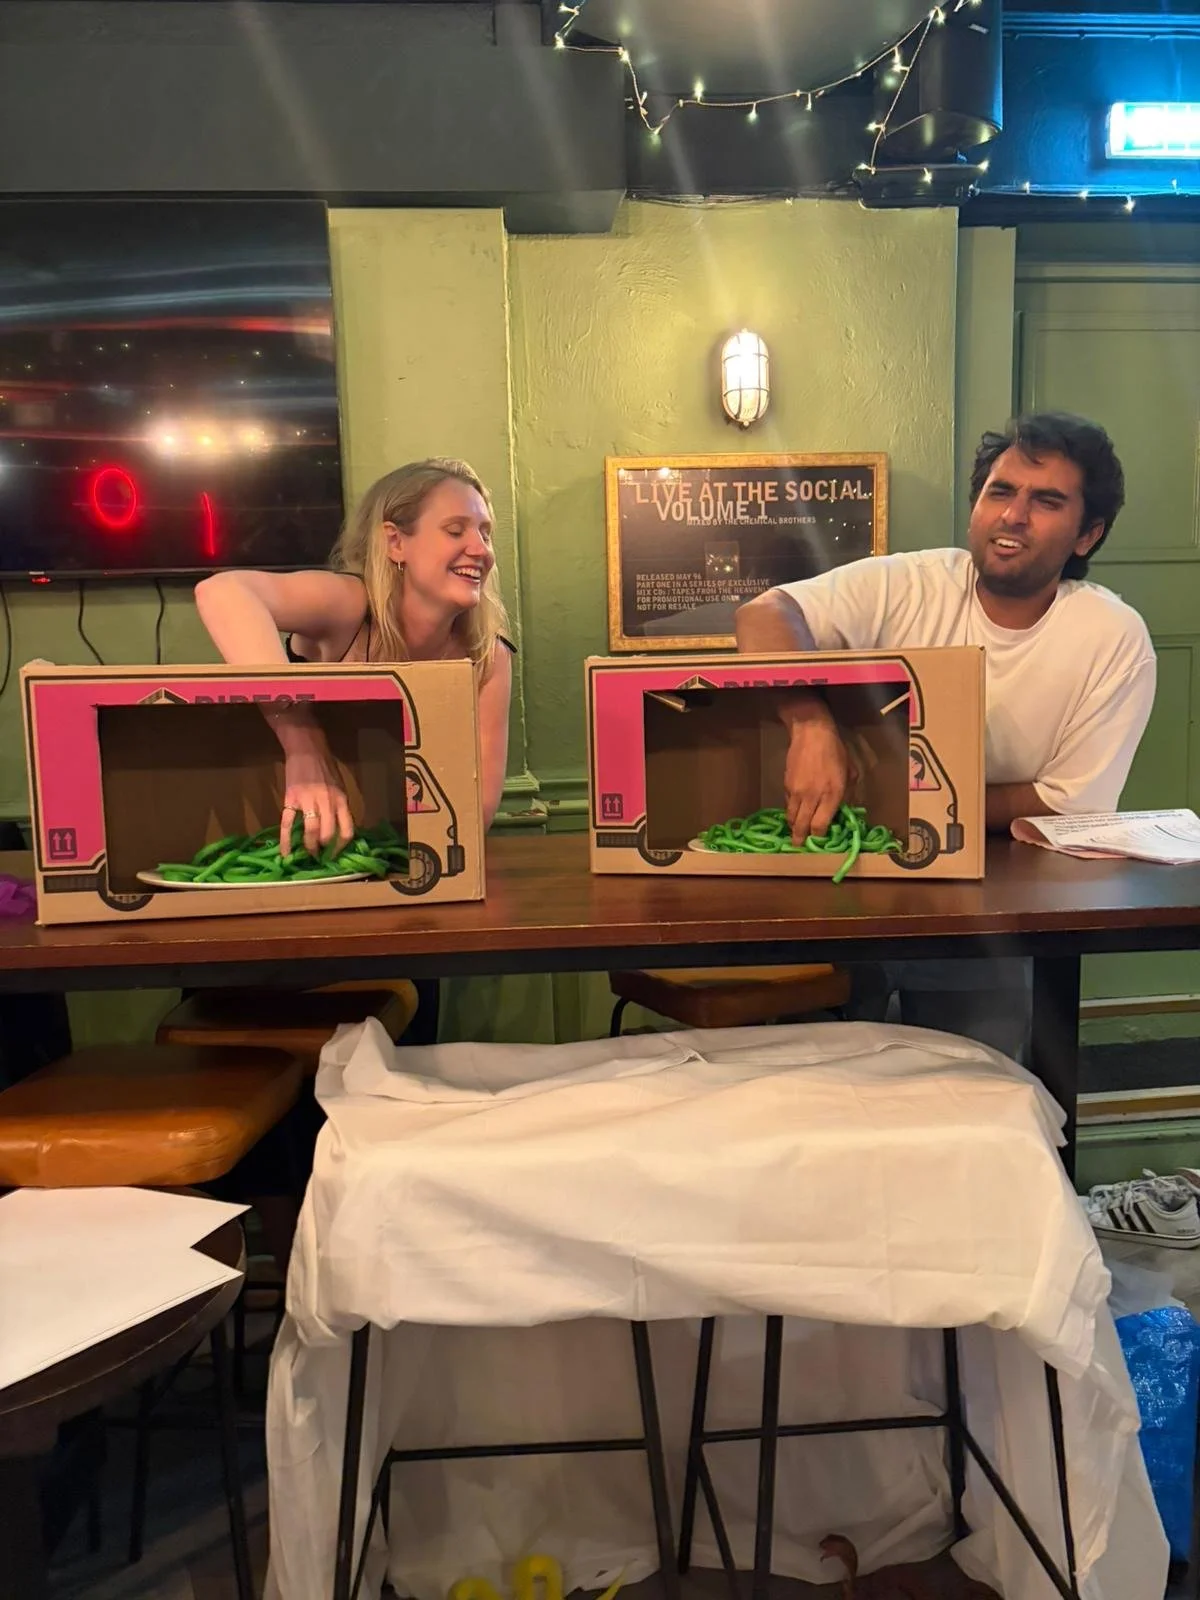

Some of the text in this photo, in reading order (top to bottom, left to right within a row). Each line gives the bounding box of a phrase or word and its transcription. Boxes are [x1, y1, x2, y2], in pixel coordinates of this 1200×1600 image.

[636, 479, 869, 503] LIVE AT THE SOCIAL
[656, 500, 768, 521] VOLUME 1
[713, 517, 723, 526] BY
[724, 517, 738, 526] THE
[740, 516, 778, 526] CHEMICAL
[779, 515, 817, 525] BROTHERS
[636, 573, 675, 581] RELEASED
[689, 580, 716, 588] SERIES
[728, 578, 770, 587] EXCLUSIVE
[672, 588, 696, 596] TAPES
[719, 587, 731, 595] THE
[636, 603, 697, 611] NOT FOR RESALE
